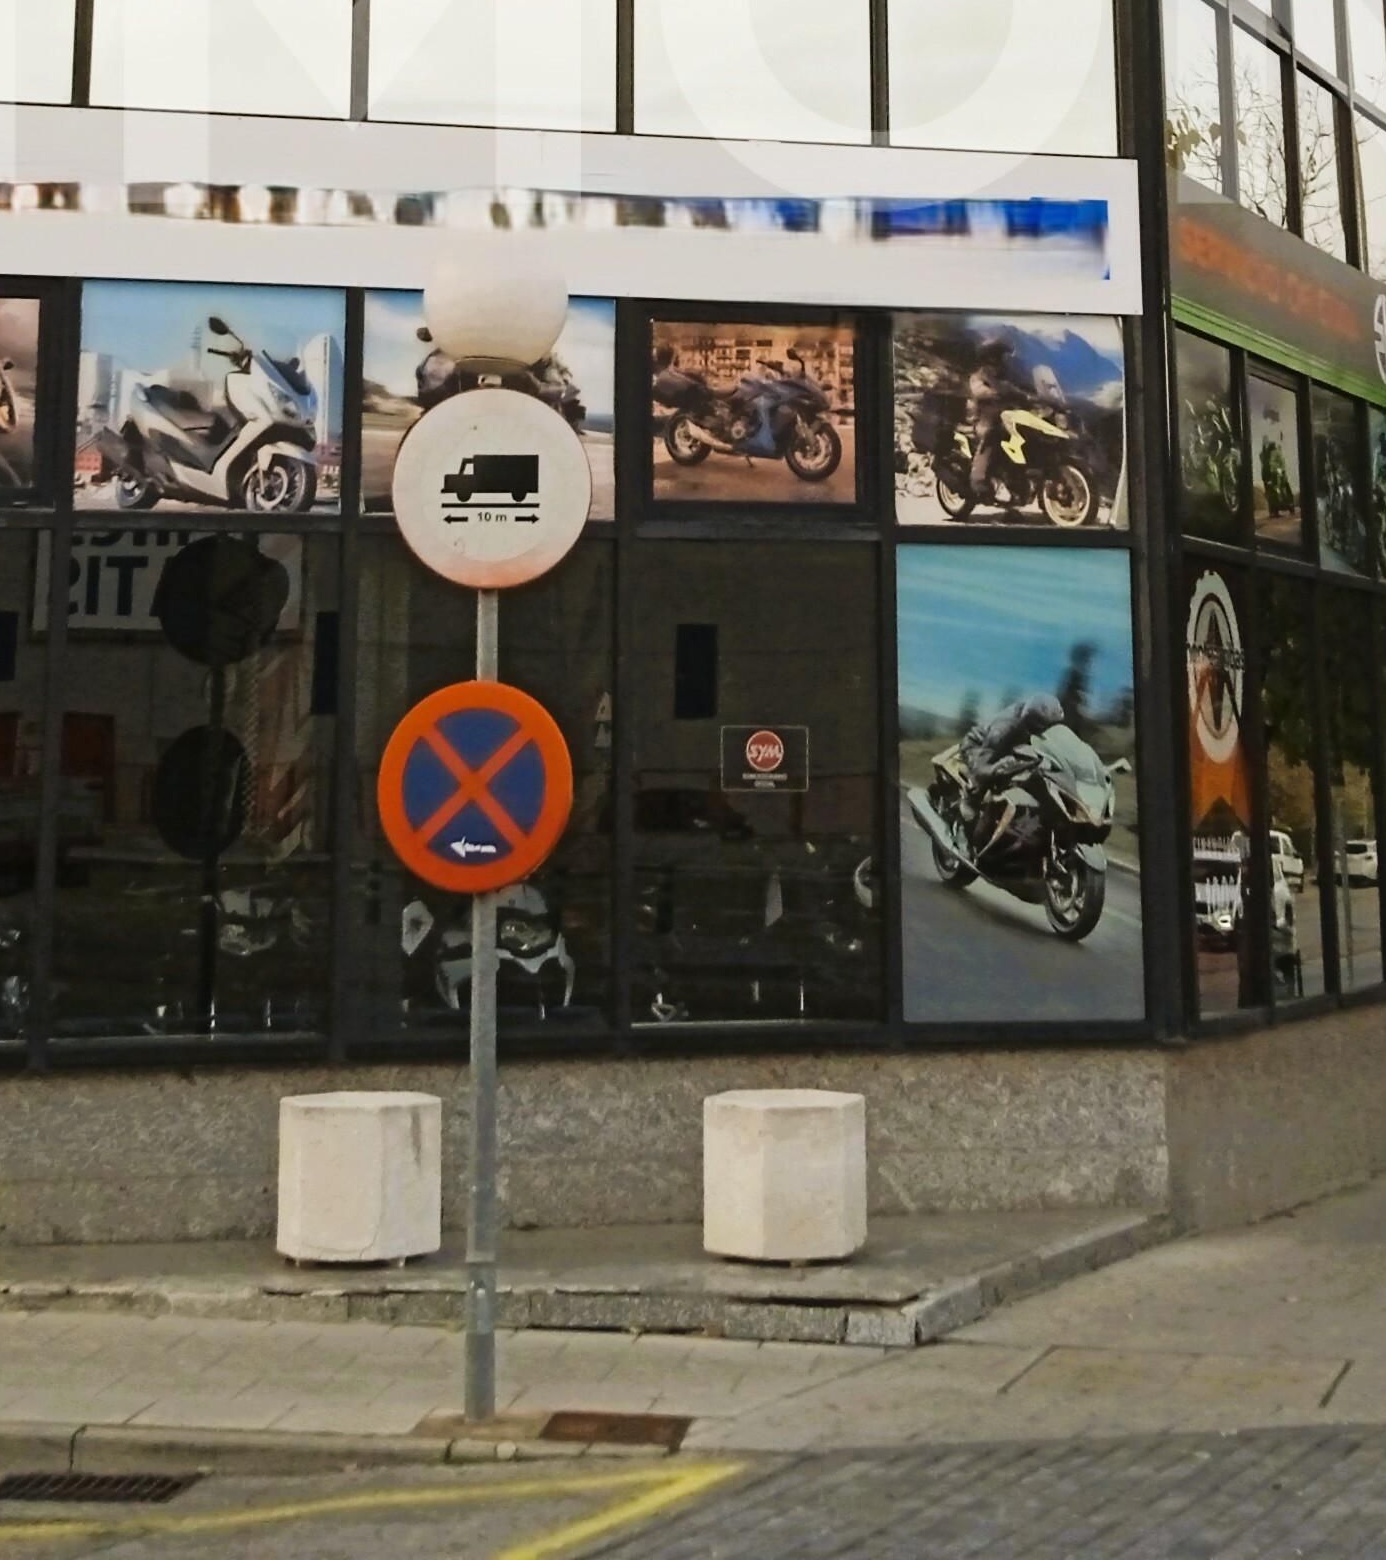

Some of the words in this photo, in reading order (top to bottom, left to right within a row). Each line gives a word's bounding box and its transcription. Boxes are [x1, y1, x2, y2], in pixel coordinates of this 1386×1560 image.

[477, 511, 492, 522] 10
[495, 513, 507, 522] m
[749, 744, 781, 762] SYM
